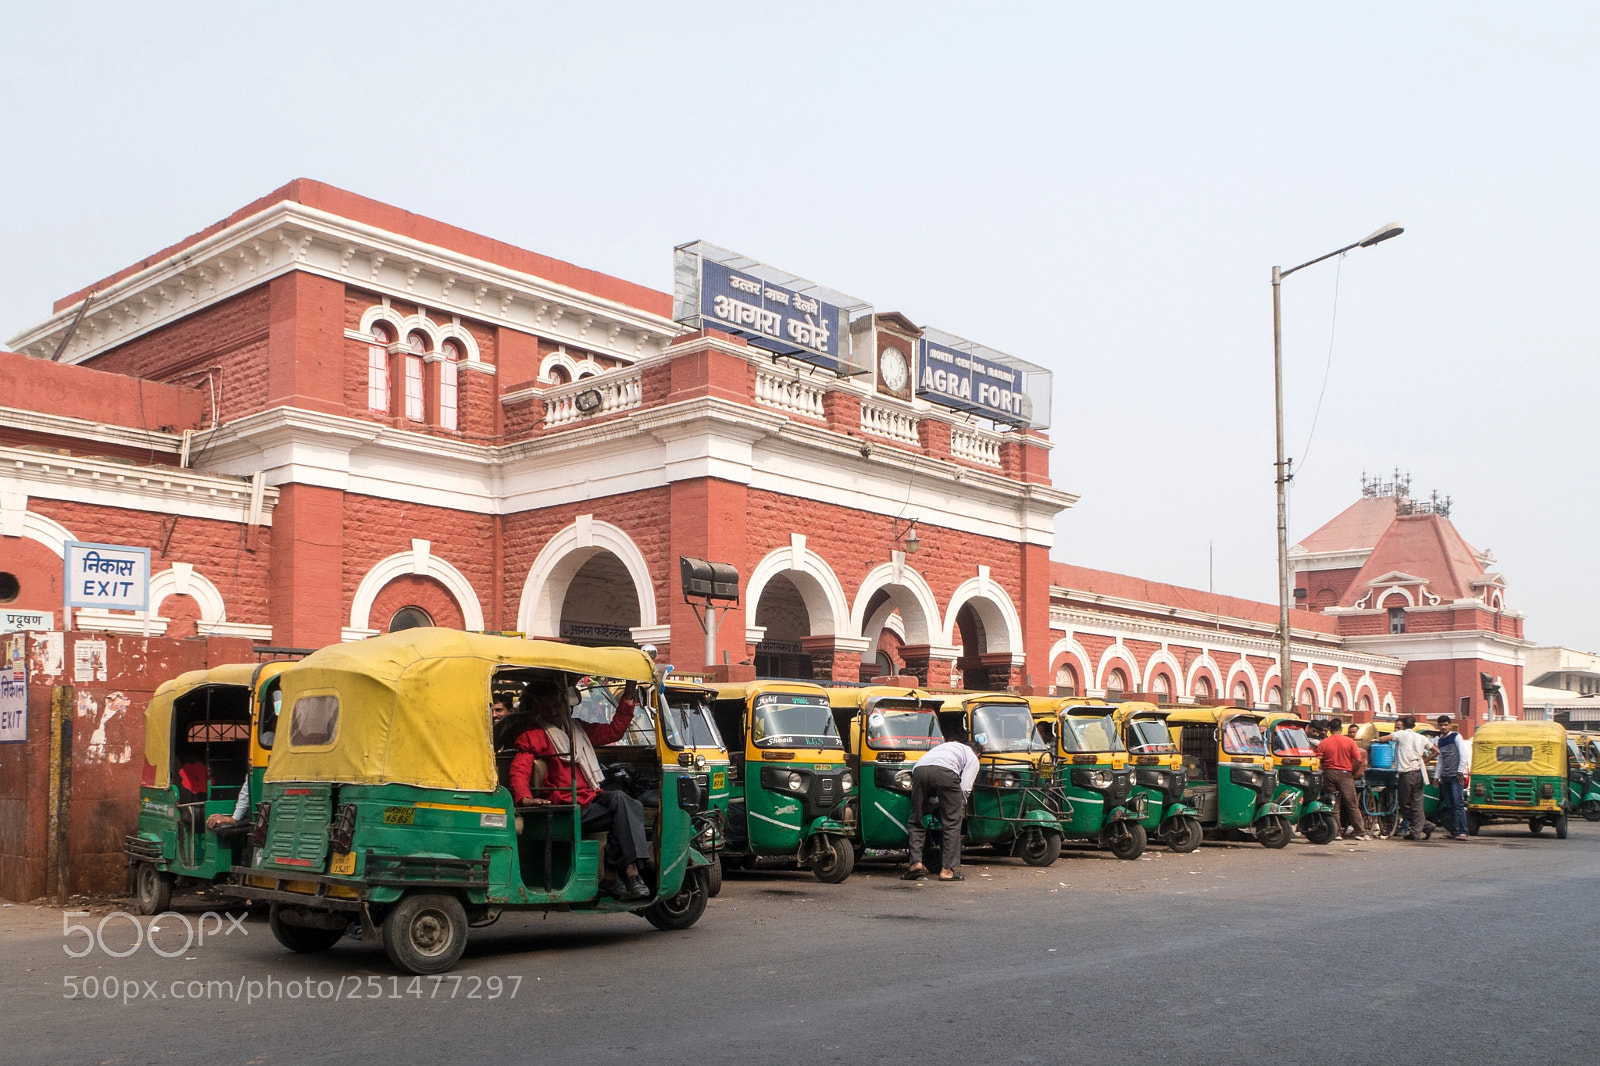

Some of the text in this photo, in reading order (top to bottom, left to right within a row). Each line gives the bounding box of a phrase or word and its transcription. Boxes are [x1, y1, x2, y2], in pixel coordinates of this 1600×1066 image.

[729, 275, 762, 295] उत्तर
[713, 295, 830, 351] आगरा फोर्ट
[929, 348, 1016, 383] NORTH CENTRAL RAILWAY
[920, 366, 1023, 414] AGRA FORT
[82, 551, 136, 576] निकास
[83, 580, 134, 597] EXIT
[6, 614, 43, 629] प्रदूषण
[1, 710, 23, 730] EXIT
